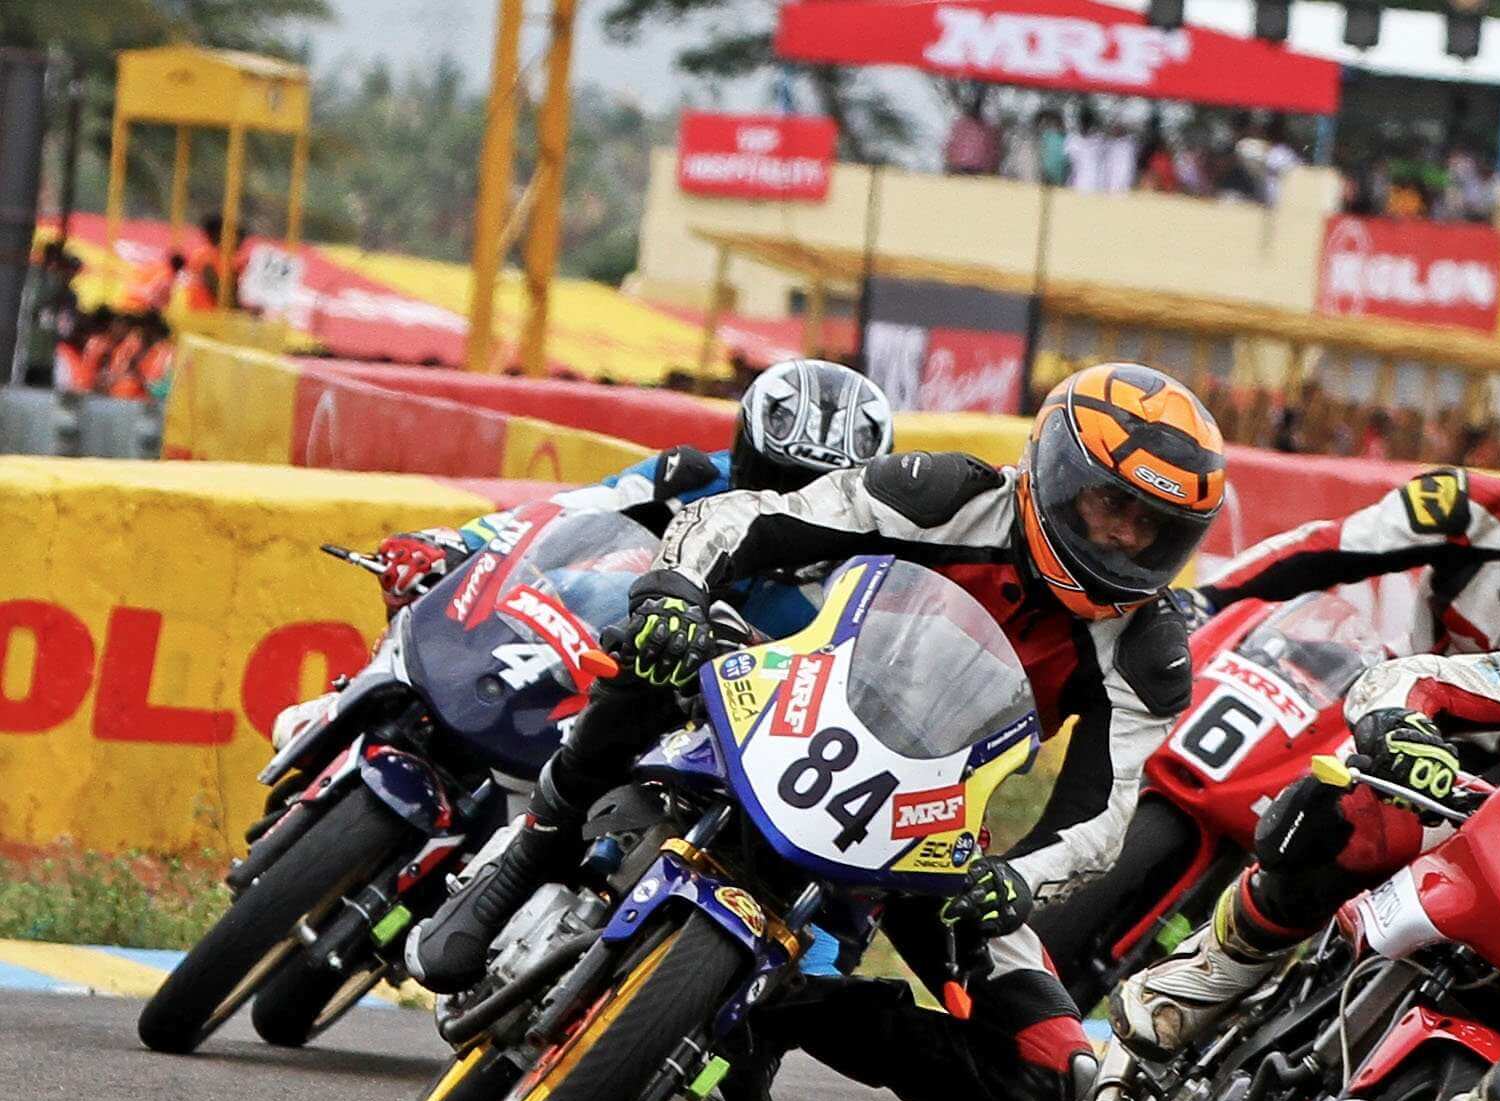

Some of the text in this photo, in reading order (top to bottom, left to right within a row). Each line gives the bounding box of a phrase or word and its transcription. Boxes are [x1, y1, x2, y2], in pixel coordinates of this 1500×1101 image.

[922, 6, 1190, 86] MRF
[491, 643, 563, 690] 4
[783, 656, 823, 734] MRF
[1216, 659, 1307, 721] MRF
[1181, 694, 1264, 769] 6
[777, 726, 900, 853] 84
[895, 795, 964, 828] MRF
